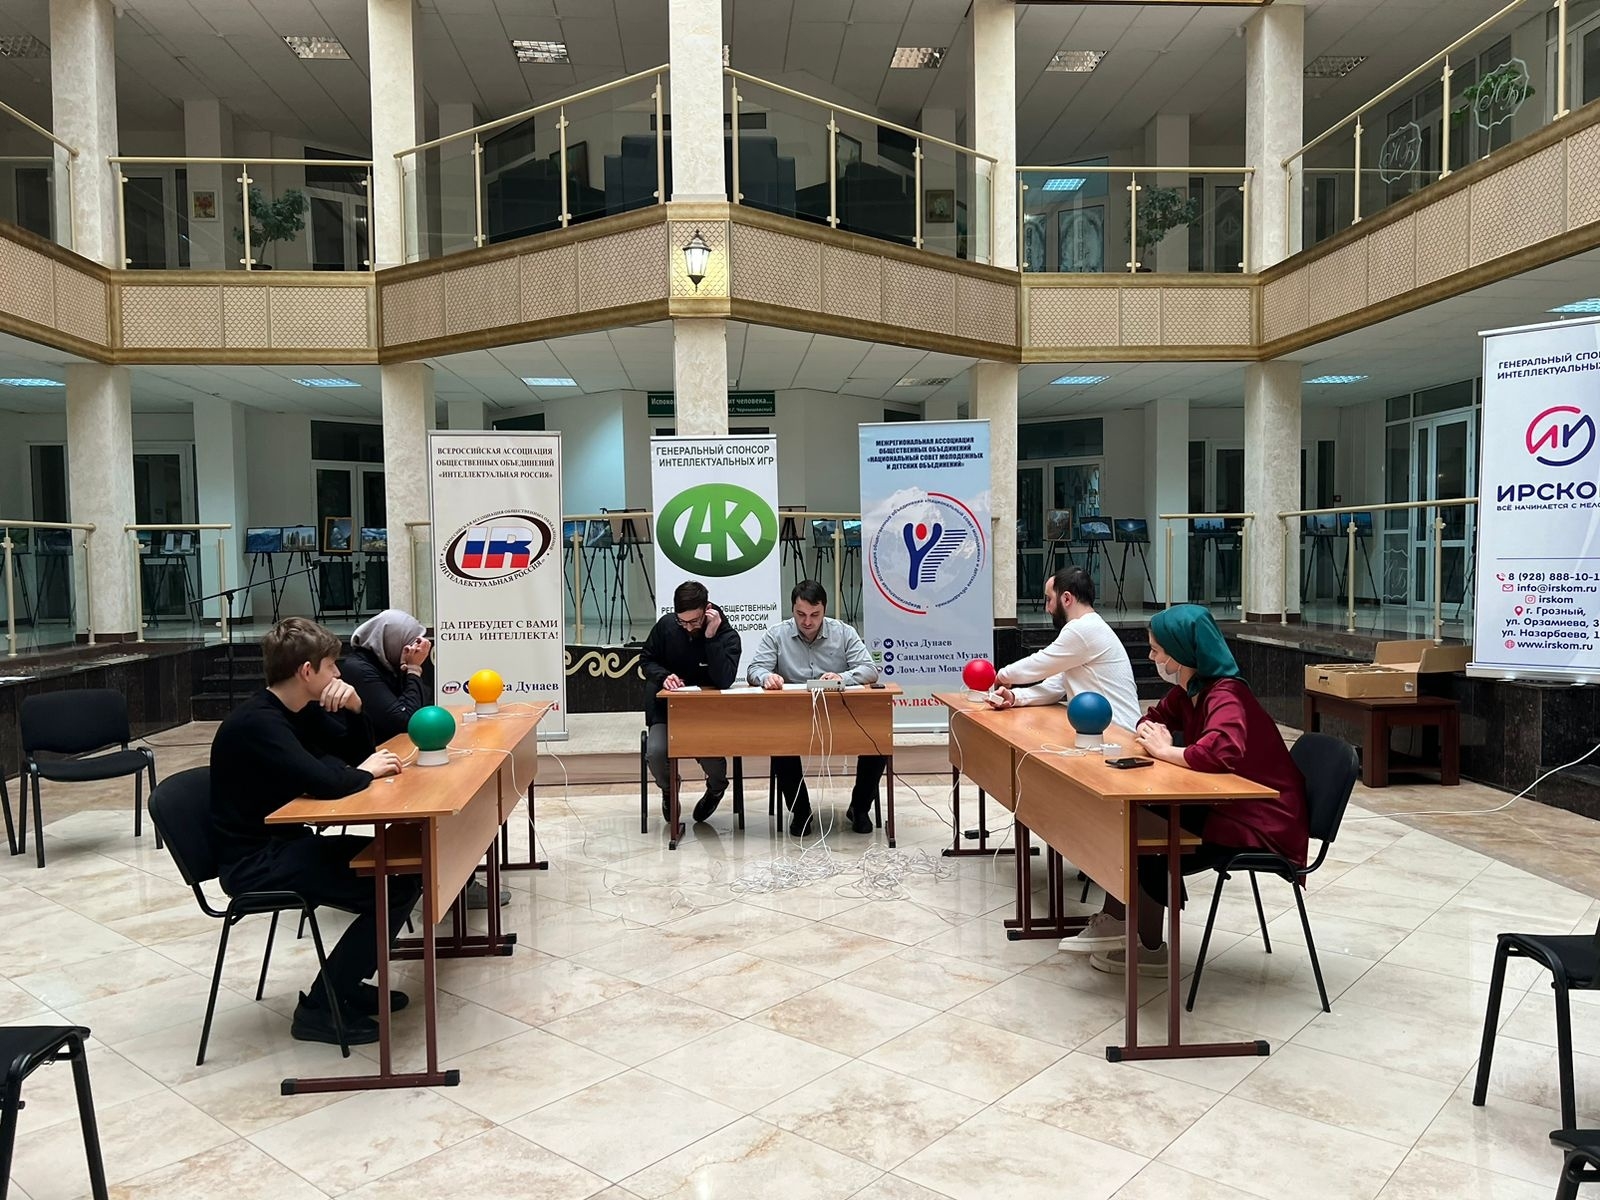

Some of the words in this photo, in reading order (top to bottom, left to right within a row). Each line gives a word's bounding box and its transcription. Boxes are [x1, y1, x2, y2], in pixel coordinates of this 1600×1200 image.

[1498, 353, 1572, 369] ГЕНЕРАЛЬНЫЙ
[1576, 351, 1600, 361] СПО
[875, 438, 934, 447] МЕЖРЕГИОНАЛЬНАЯ
[935, 437, 974, 445] АССОЦИАЦИЯ
[437, 446, 501, 455] ВСЕРОССИЙСКАЯ
[503, 447, 553, 456] АССОЦИАЦИЯ
[656, 444, 724, 456] ГЕНЕРАЛЬНЫЙ
[726, 445, 770, 455] СПОНСОР
[879, 446, 928, 455] ОБЩЕСТВЕННЫХ
[928, 444, 971, 453] ОБЪЕДИНЕНИЙ
[436, 459, 499, 467] ОБЩЕСТВЕННЫХ
[500, 458, 554, 467] ОБЪЕДИНЕНИЙ
[659, 457, 755, 467] ИНТЕЛЛЕКТУАЛЬНЫХ
[757, 456, 774, 465] ИГР
[892, 462, 918, 470] ДЕТСКИХ
[439, 471, 519, 479] «ИНТЕЛЛЕКТУАЛЬНАЯ
[520, 471, 553, 479] РОССИЯ»
[1497, 481, 1598, 502] ИРСКО
[1496, 504, 1512, 512] ВСЁ
[1514, 503, 1569, 511] НАЧИНАЕТСЯ
[1508, 572, 1515, 581] 8
[1518, 572, 1546, 582] (928)
[1517, 584, 1597, 593] info@irskom.ru
[1539, 595, 1574, 604] irskom
[720, 602, 777, 613] ОБЩЕСТВЕННЫЙ
[1536, 606, 1586, 617] Грозный,
[726, 614, 740, 622] РОЯ
[741, 614, 769, 622] РОССИИ
[1505, 618, 1520, 627] ул.
[440, 621, 456, 630] ДА
[458, 620, 514, 631] ПРЕБУДЕТ
[516, 620, 524, 629] С
[526, 620, 558, 629] ВАМИ
[440, 632, 473, 641] СИЛА
[479, 631, 559, 640] ИНТЕЛЛЕКТА!
[1501, 629, 1516, 638] ул.
[1519, 628, 1590, 640] Назарбаева,
[896, 639, 919, 649] Муса
[920, 638, 953, 649] Дунаев
[1517, 640, 1593, 651] www.irskom.ru
[896, 665, 936, 674] Лом-Али
[515, 680, 559, 694] Дунаев
